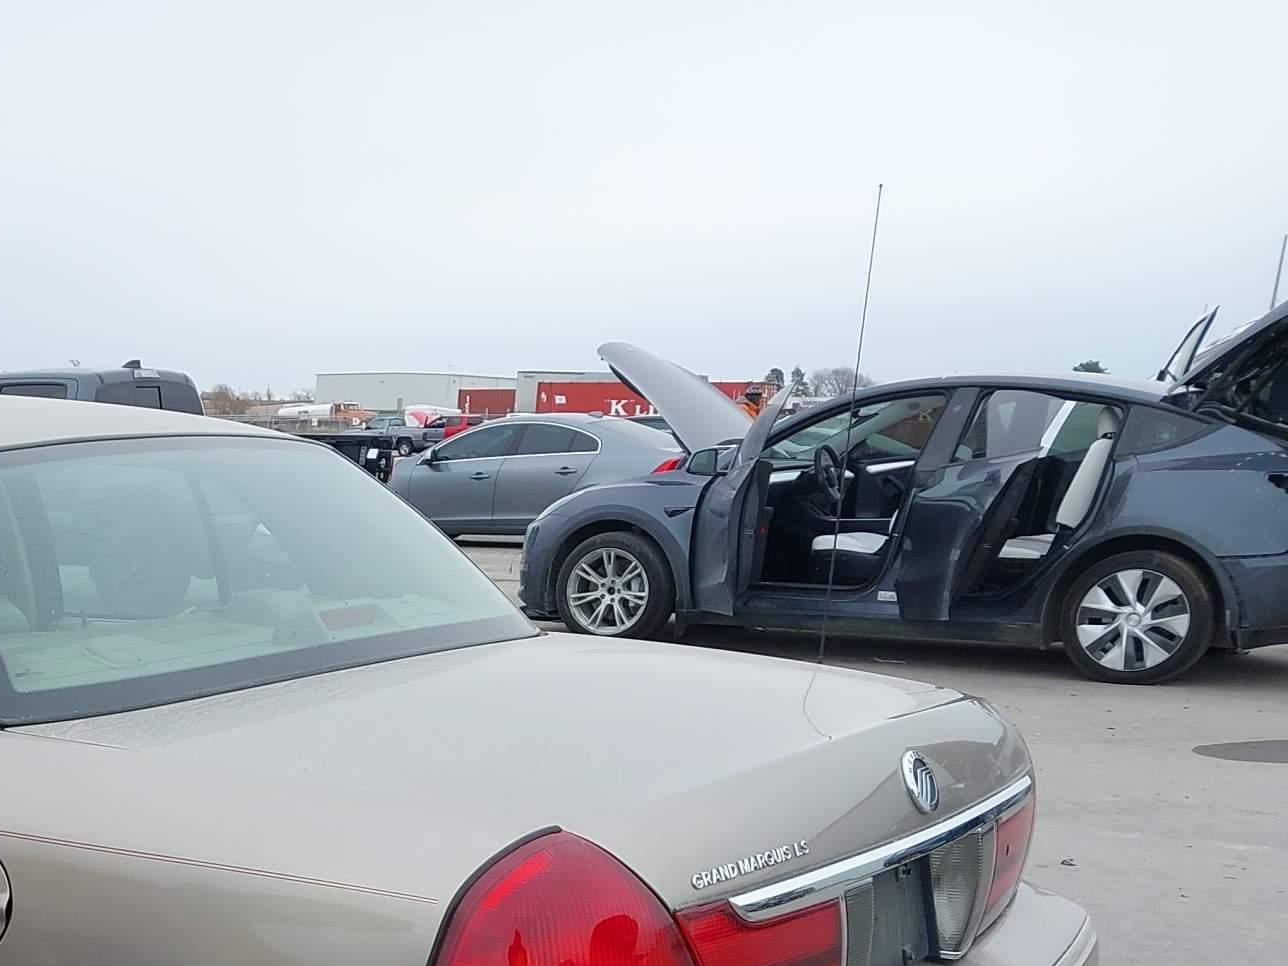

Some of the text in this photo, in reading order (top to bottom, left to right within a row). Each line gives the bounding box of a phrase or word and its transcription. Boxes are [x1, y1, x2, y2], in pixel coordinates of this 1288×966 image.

[691, 839, 810, 889] GRAND MARQUIS LS
